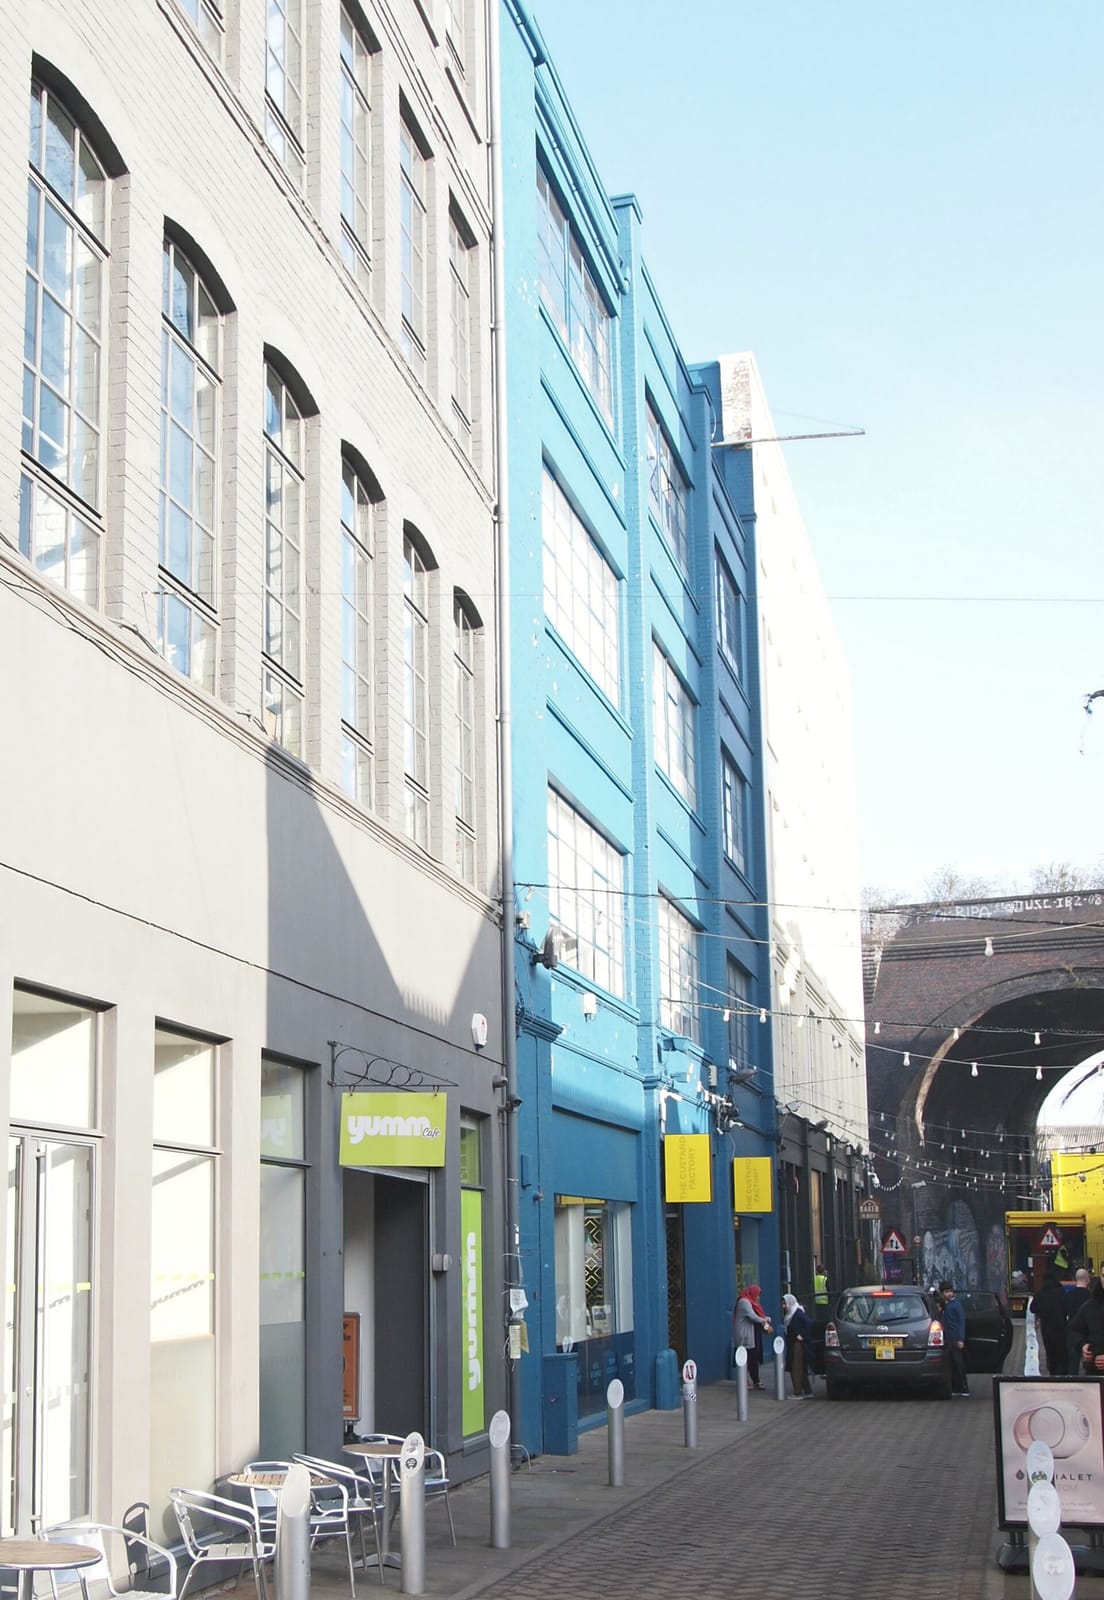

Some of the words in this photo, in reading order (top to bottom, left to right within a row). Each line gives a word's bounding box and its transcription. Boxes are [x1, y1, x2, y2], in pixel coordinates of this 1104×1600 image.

[348, 1115, 430, 1144] yumm
[467, 1232, 481, 1391] yumm
[1055, 1473, 1093, 1481] IALET
